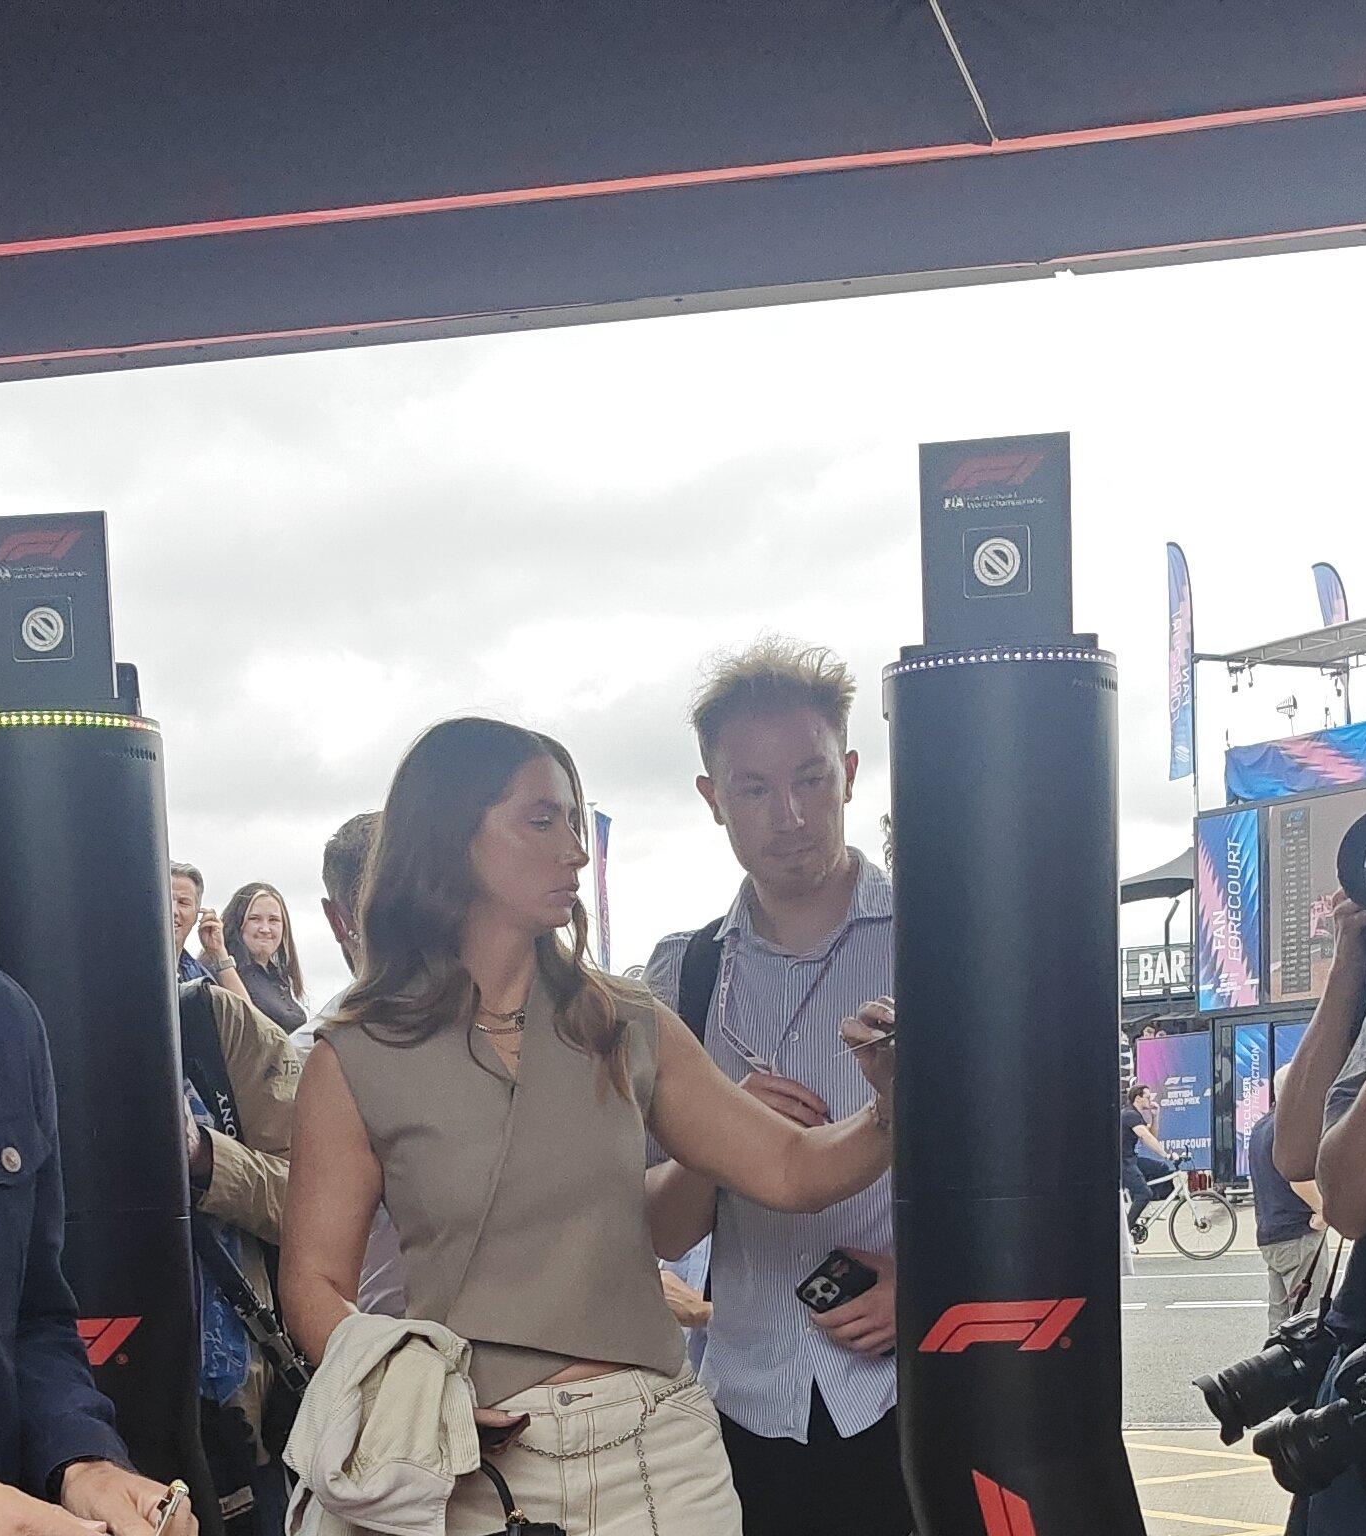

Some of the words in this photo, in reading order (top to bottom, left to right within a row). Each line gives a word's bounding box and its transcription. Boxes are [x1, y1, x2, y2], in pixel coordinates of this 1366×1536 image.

[1227, 838, 1243, 962] FORECOURT
[1212, 910, 1227, 951] FAN
[1138, 949, 1186, 986] BAR
[1251, 1045, 1260, 1086] ACTION
[215, 1090, 237, 1139] ONY
[1243, 1076, 1251, 1120] CLOSER
[1165, 1137, 1212, 1150] FORECOURT
